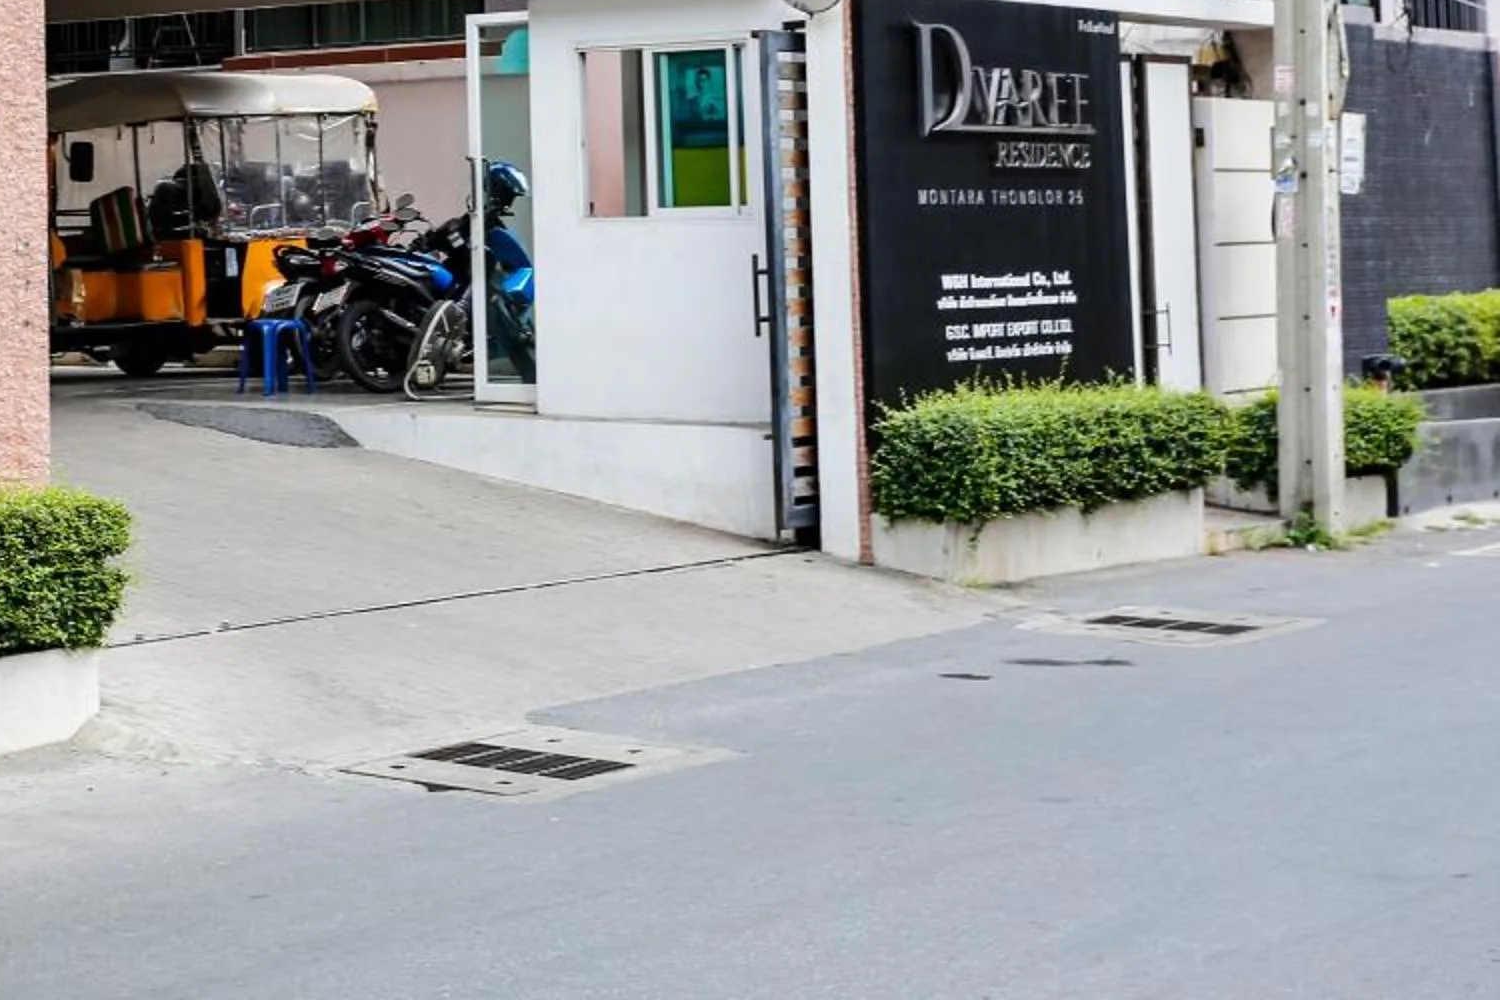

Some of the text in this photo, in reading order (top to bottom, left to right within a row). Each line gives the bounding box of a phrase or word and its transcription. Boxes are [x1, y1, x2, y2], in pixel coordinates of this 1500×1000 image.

[996, 141, 1092, 168] RESIDENCE
[917, 189, 985, 205] MONTARA
[991, 189, 1063, 205] THONGLOR
[1006, 320, 1039, 337] EXPORT
